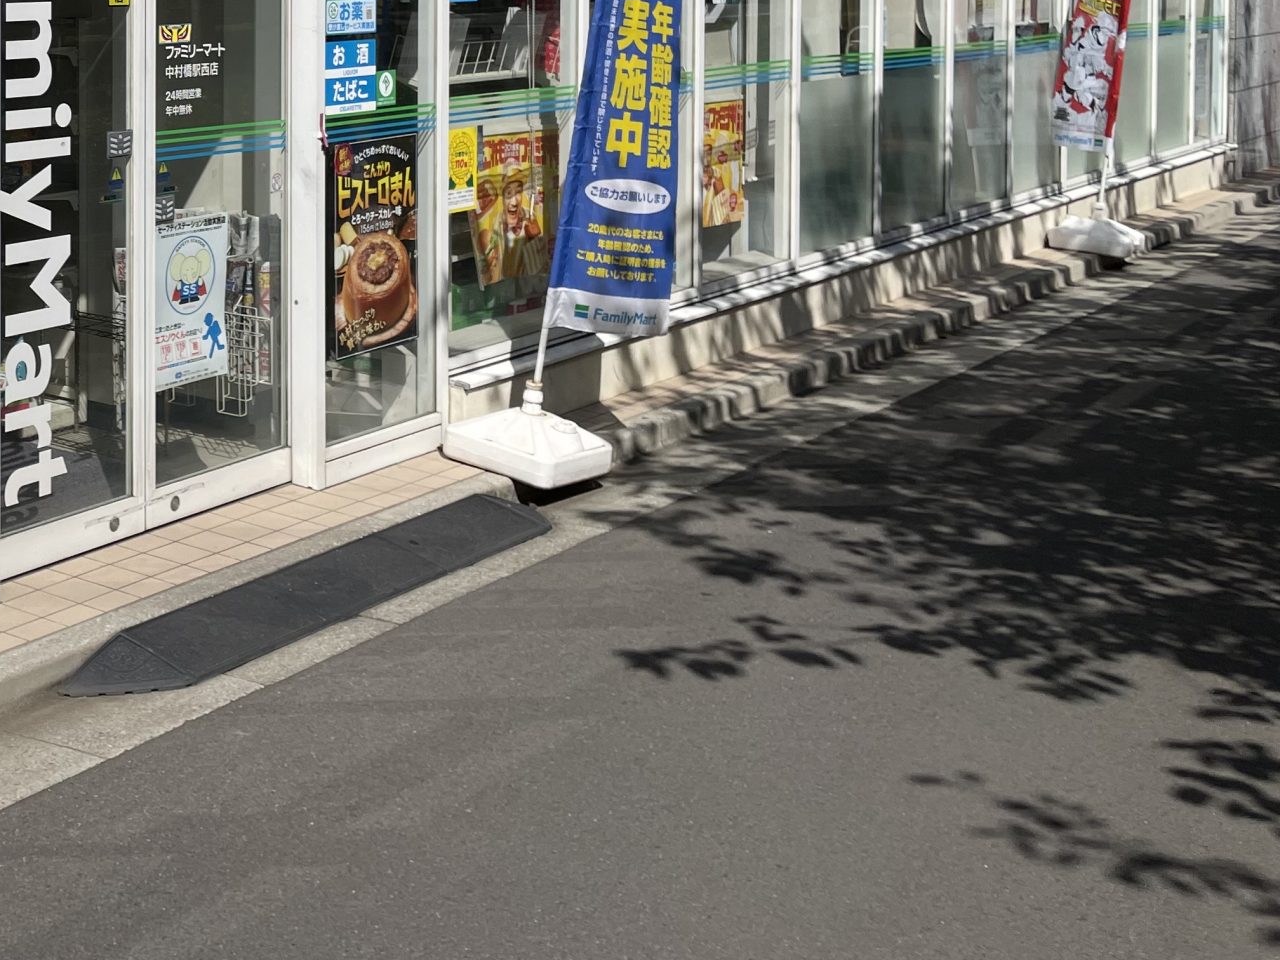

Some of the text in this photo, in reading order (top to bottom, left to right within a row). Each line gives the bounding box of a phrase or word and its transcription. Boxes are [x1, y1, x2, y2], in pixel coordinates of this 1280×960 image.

[340, 1, 363, 20] お薬
[165, 43, 226, 59] ファミリーマート
[333, 43, 369, 66] お酒
[165, 62, 219, 79] 中村橋駅西店
[333, 79, 369, 102] たばこ
[646, 0, 674, 170] 年齢確認
[165, 88, 202, 101] 24時間営業
[165, 104, 192, 117] 年中無休
[363, 161, 391, 178] こんがり
[337, 166, 416, 218] ビストロまん
[590, 186, 667, 204] ご協力お願いします
[182, 284, 197, 295] SS
[593, 308, 657, 326] FamilyMart
